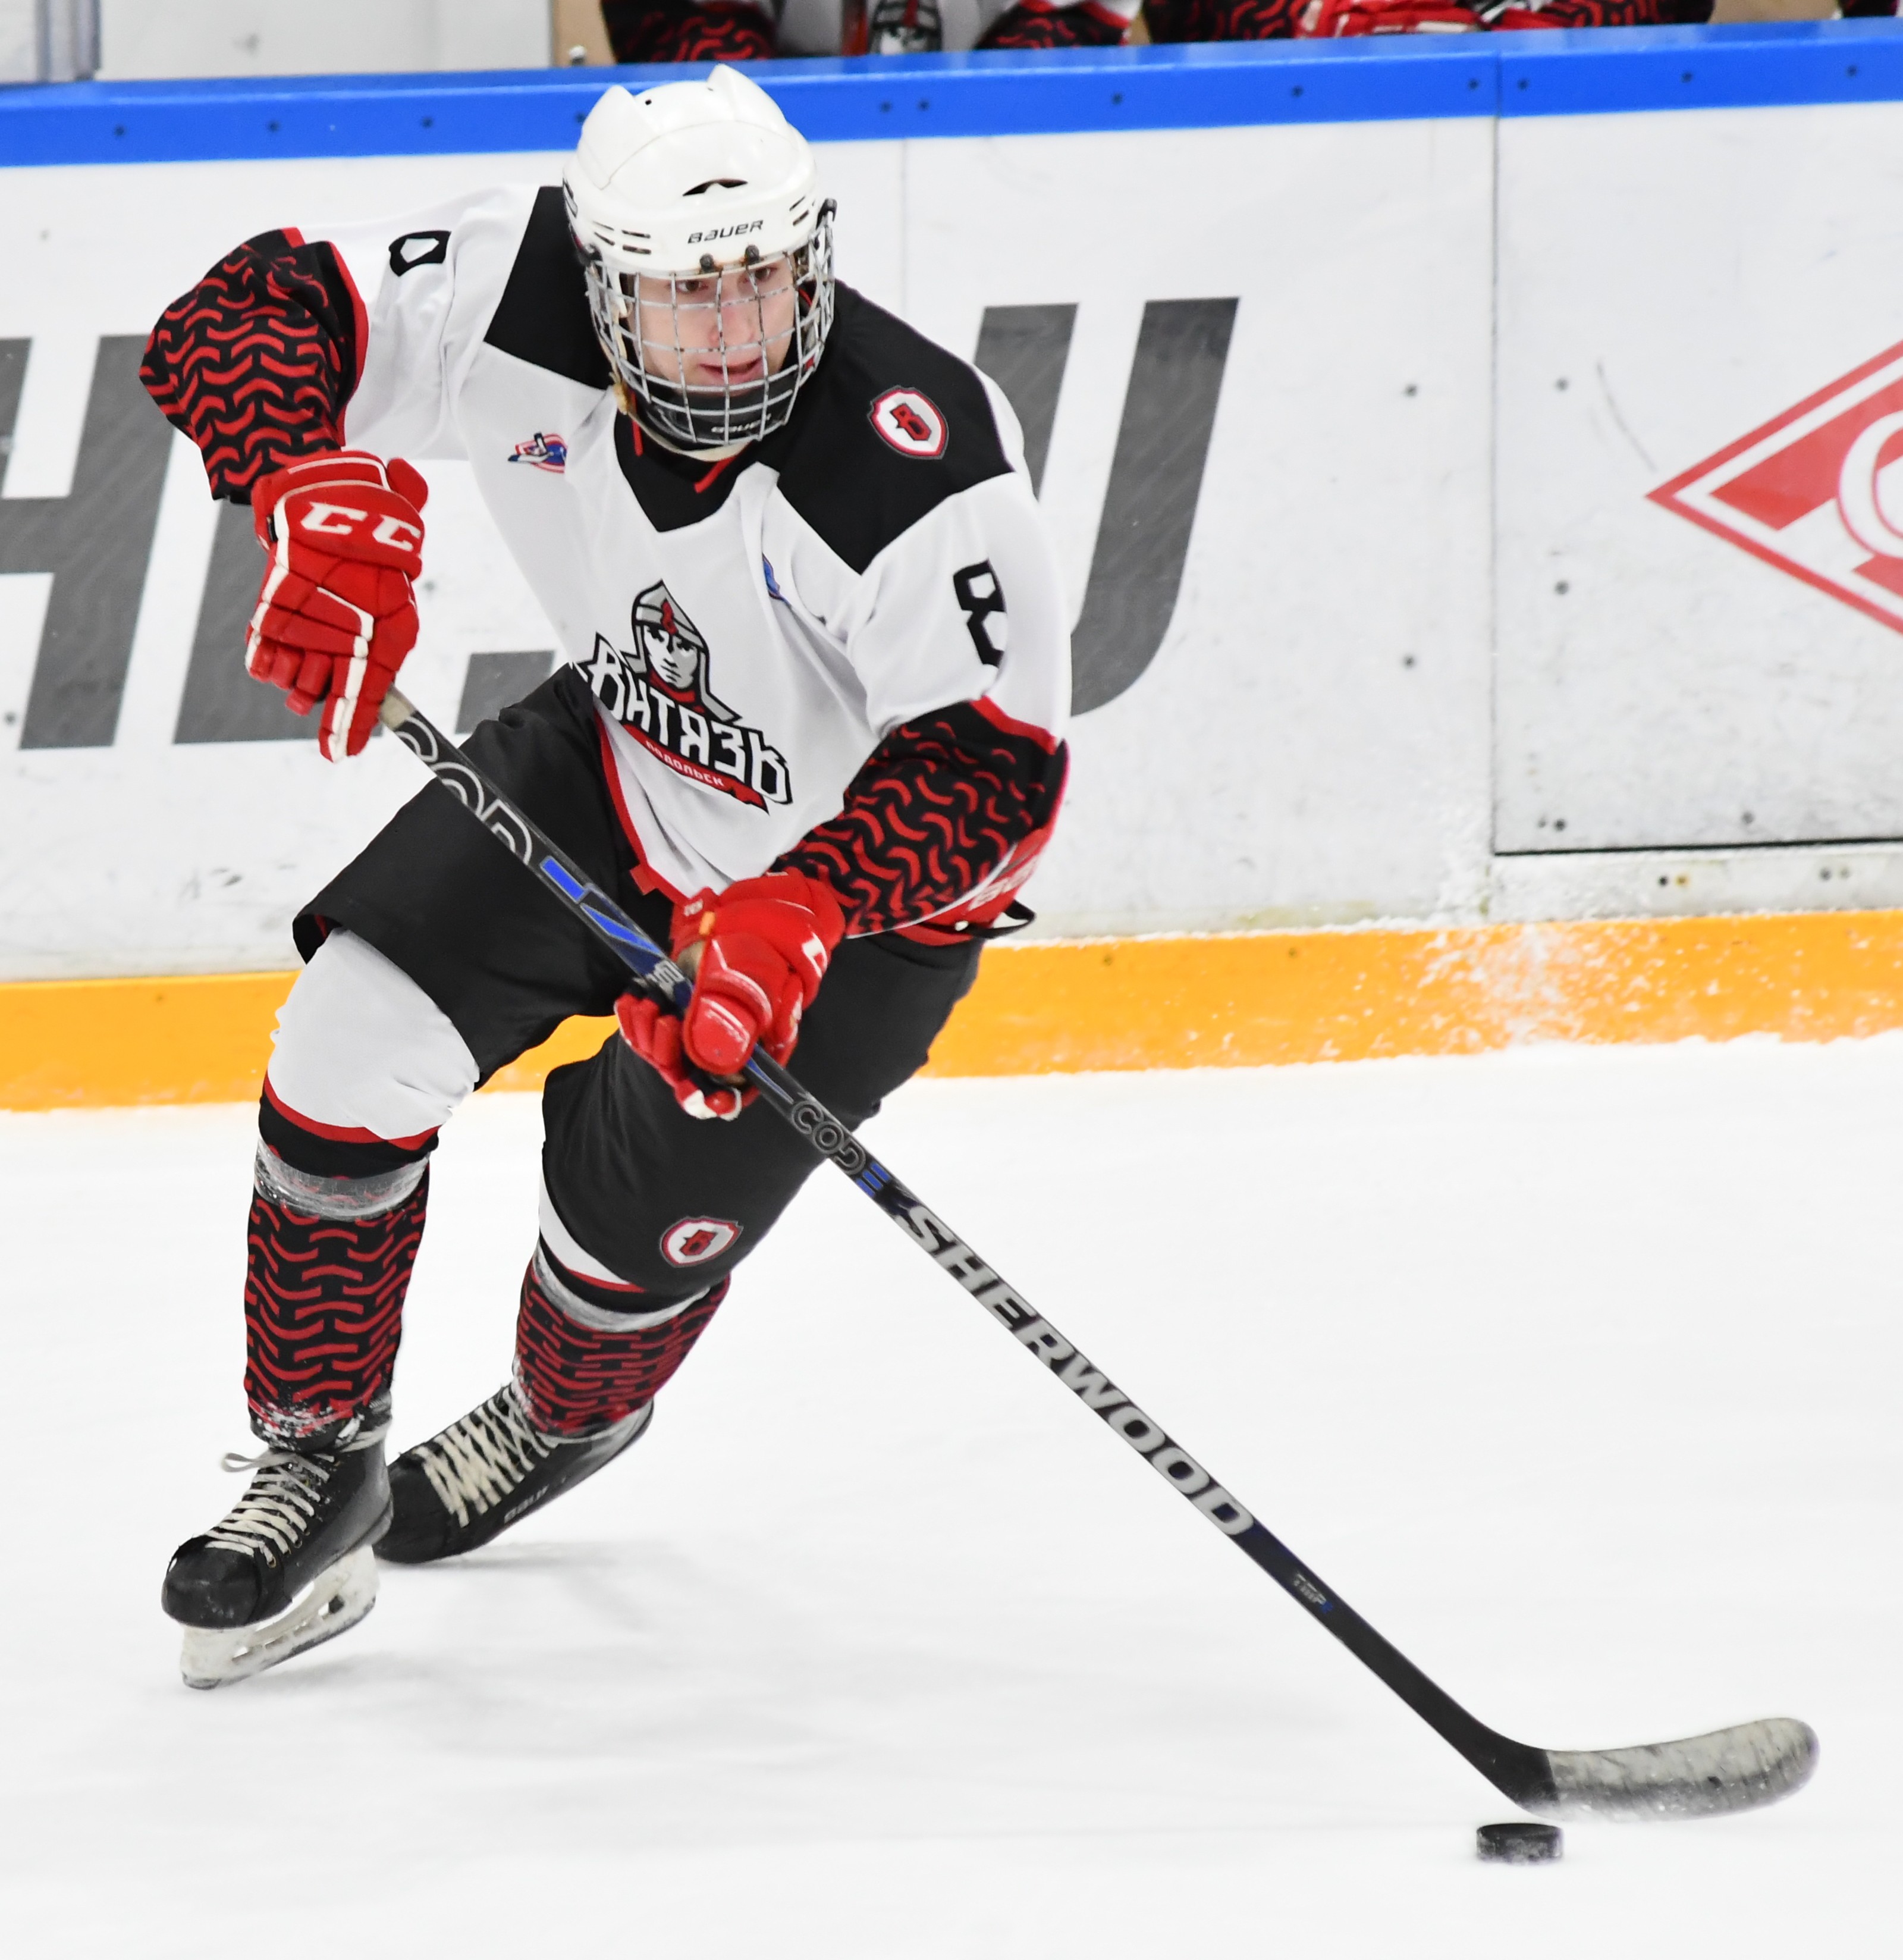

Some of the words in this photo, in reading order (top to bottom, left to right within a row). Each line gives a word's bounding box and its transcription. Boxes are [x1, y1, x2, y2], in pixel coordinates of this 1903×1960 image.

[687, 219, 764, 244] BAUER
[952, 558, 1007, 669] 8
[893, 1205, 1255, 1536] SHERWOOD
